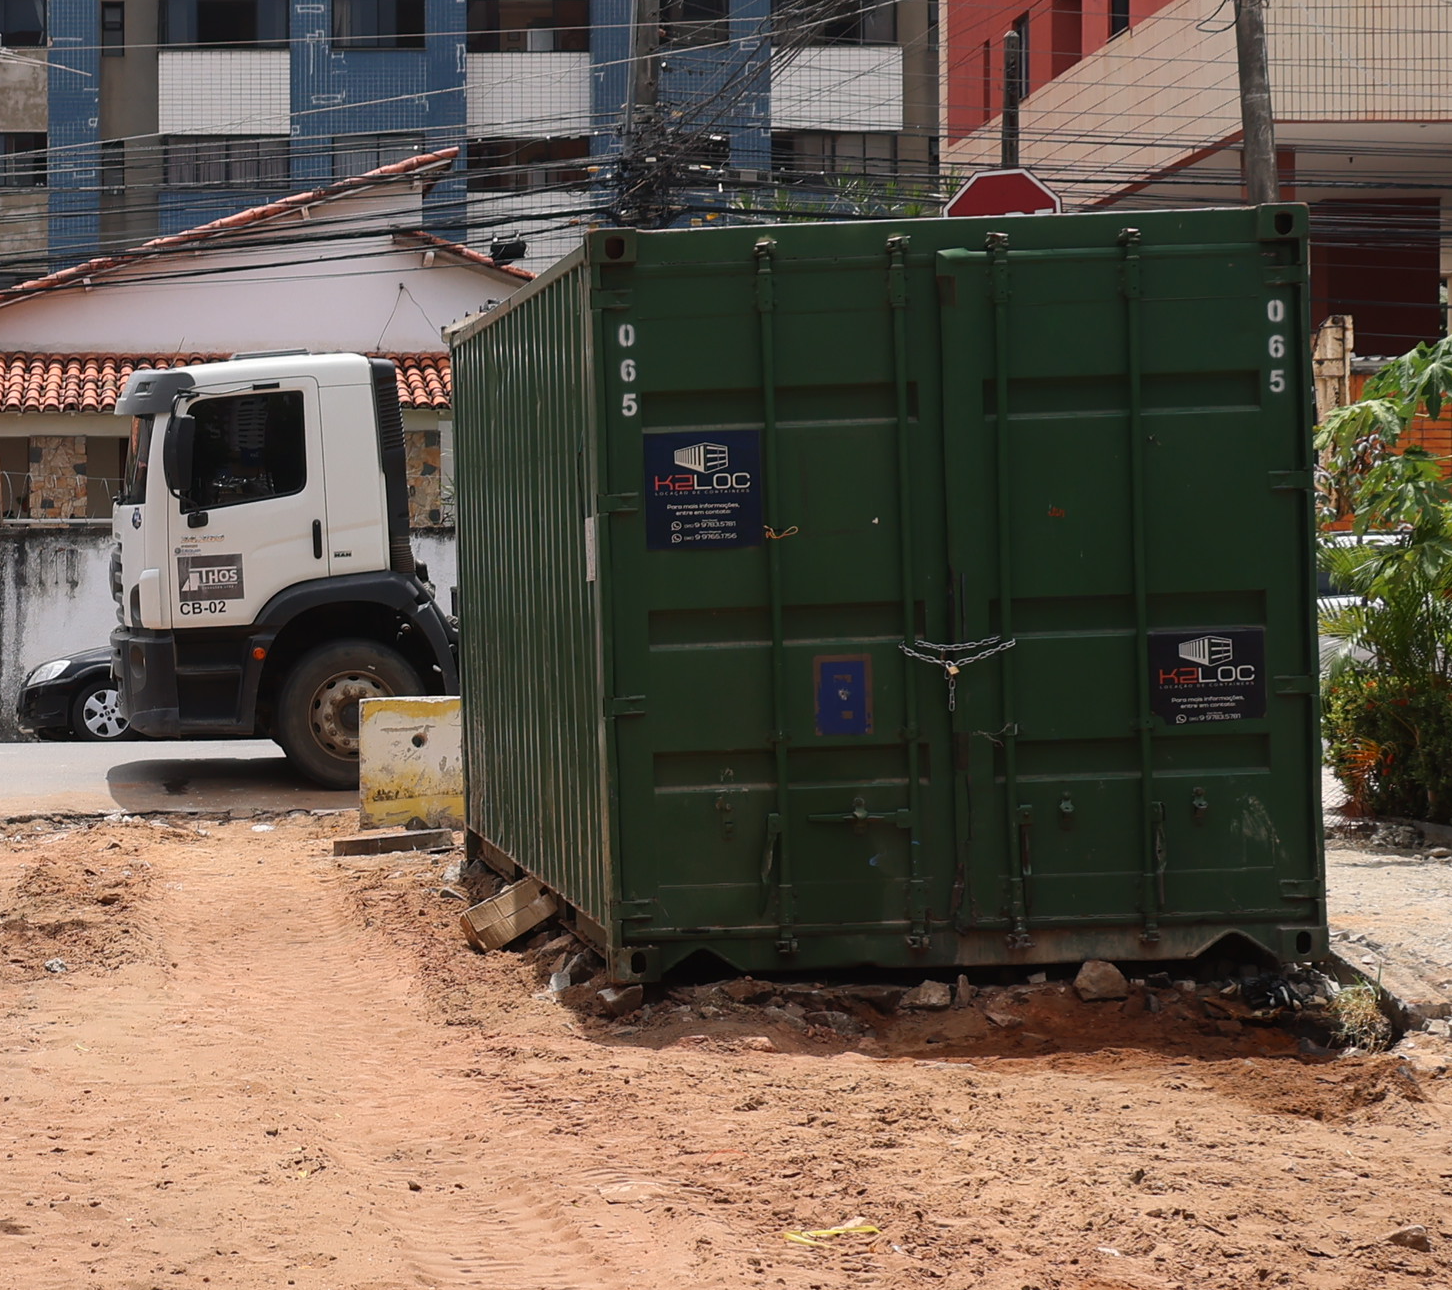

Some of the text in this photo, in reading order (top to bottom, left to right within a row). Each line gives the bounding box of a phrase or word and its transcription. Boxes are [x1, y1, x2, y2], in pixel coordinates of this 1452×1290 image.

[1267, 299, 1286, 393] 065
[618, 324, 638, 417] 065
[654, 472, 751, 491] K2LOC
[180, 600, 227, 615] CB-02
[1159, 665, 1255, 684] K2LOC
